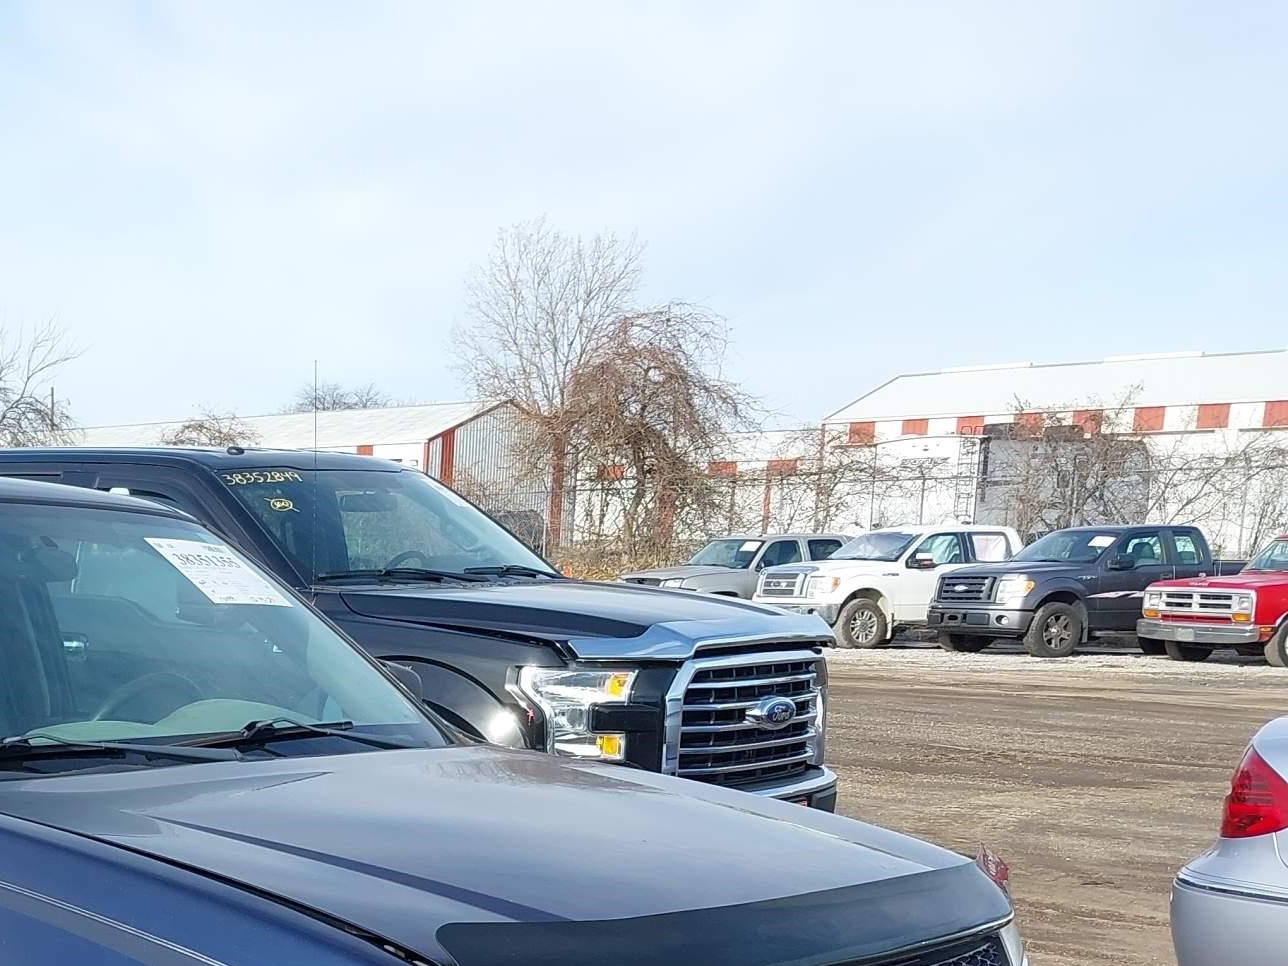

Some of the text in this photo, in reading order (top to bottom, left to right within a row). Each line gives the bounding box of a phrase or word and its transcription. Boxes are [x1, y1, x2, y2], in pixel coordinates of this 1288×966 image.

[221, 470, 303, 485] 38352849
[172, 552, 241, 569] 38351355
[772, 705, 791, 721] Ford
